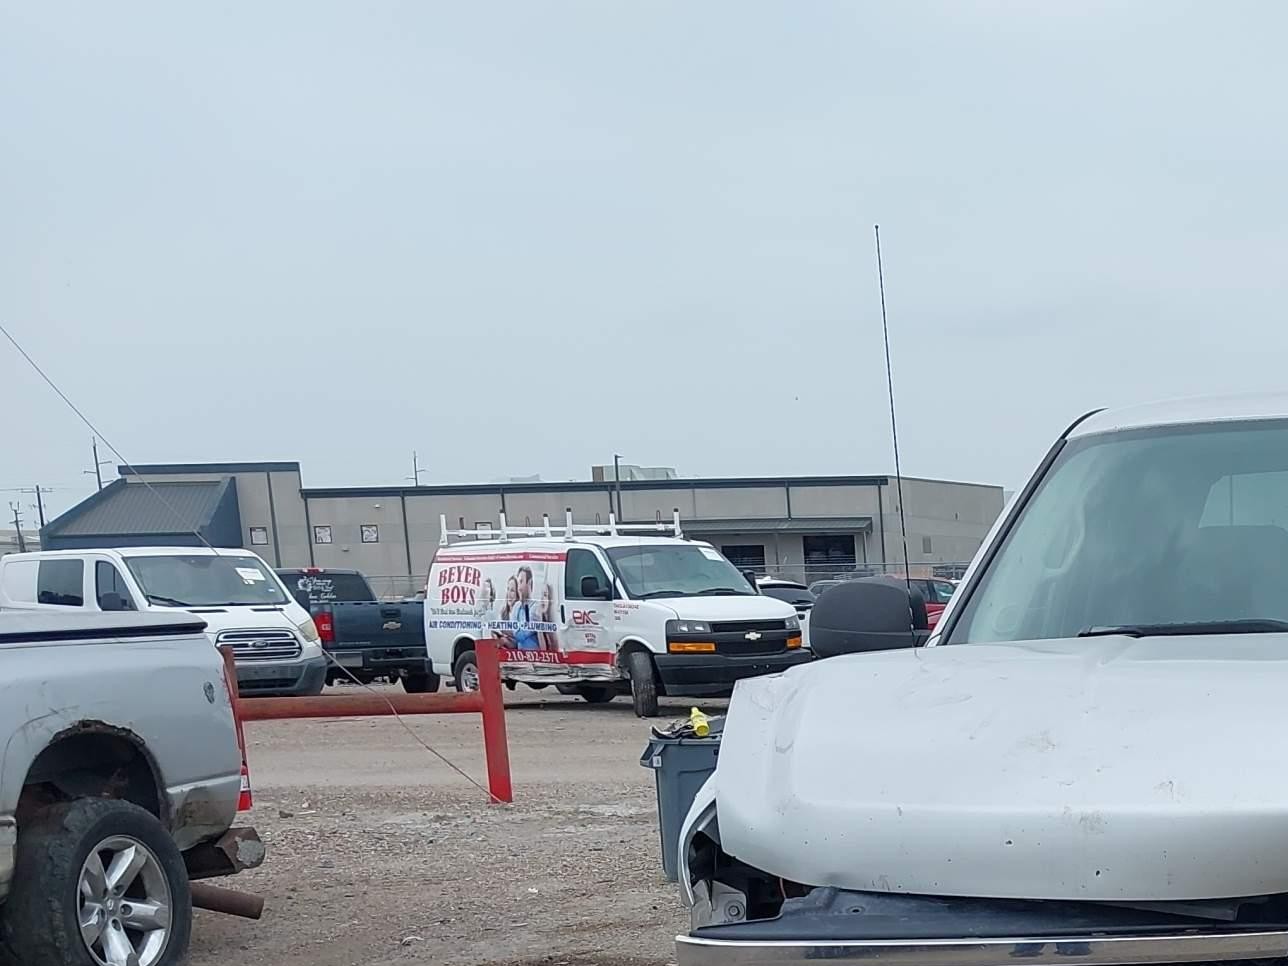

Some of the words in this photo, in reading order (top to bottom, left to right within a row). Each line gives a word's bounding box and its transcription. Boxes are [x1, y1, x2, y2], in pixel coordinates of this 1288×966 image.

[438, 565, 481, 587] BEYER
[440, 585, 476, 606] BOYS
[439, 620, 482, 629] CONDITIONING
[488, 621, 519, 630] HEATING
[524, 621, 558, 632] PLUMBING
